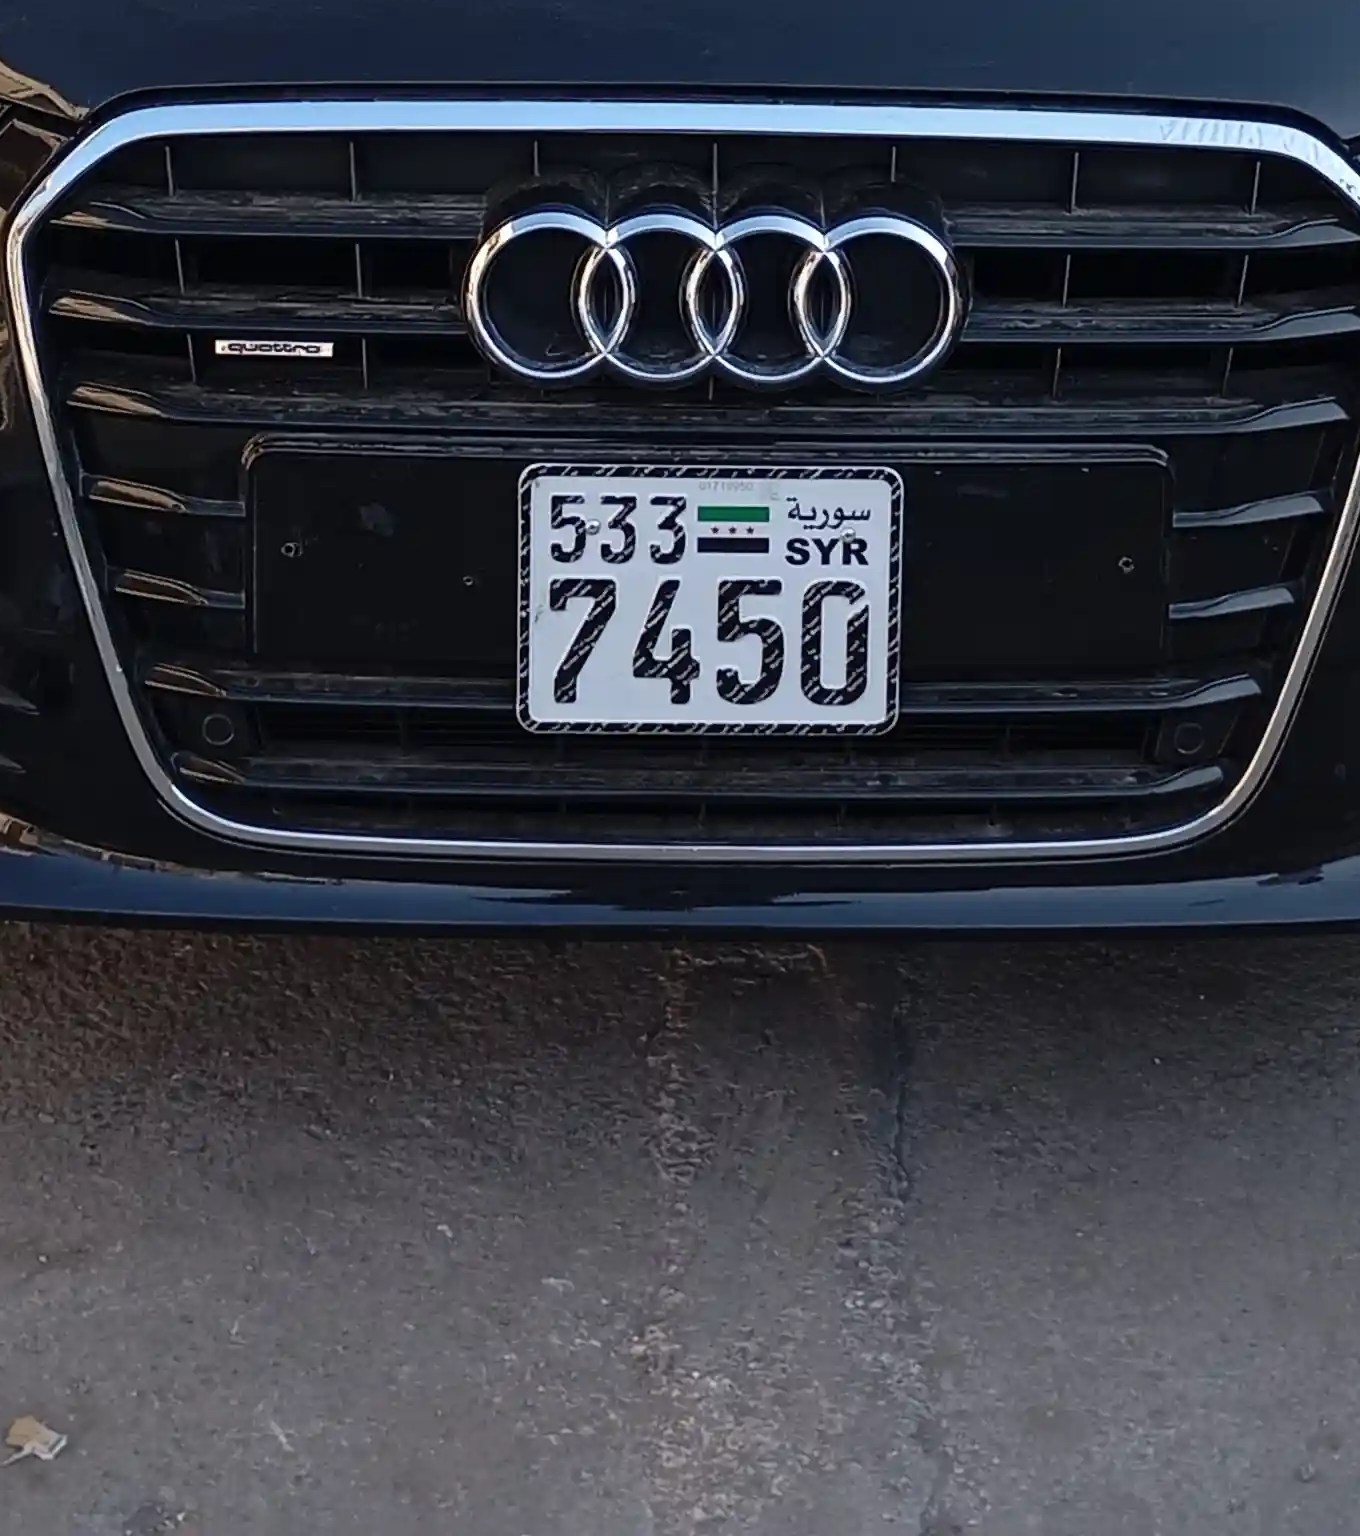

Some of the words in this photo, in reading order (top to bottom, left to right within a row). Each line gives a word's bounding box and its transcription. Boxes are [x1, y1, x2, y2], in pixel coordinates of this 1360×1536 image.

[228, 343, 321, 355] quattro
[550, 494, 687, 565] 533
[786, 496, 871, 530] سورية
[784, 536, 869, 565] SYR
[549, 578, 870, 706] 7450
